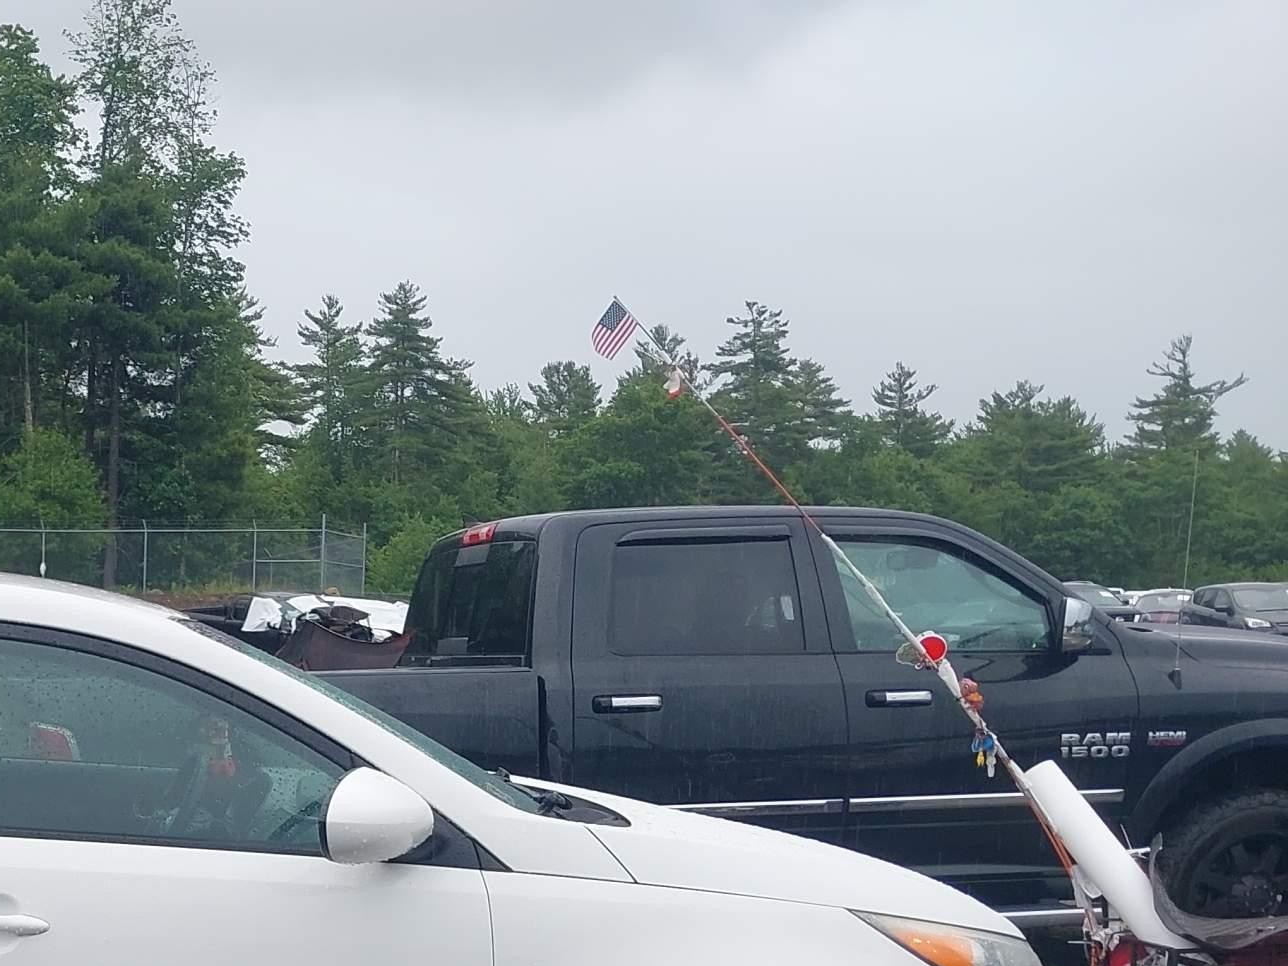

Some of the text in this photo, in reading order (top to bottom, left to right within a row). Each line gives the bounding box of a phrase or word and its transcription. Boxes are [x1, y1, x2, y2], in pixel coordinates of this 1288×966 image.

[1061, 732, 1131, 745] RAM
[1148, 731, 1187, 742] HEMI
[1060, 745, 1130, 758] 1500
